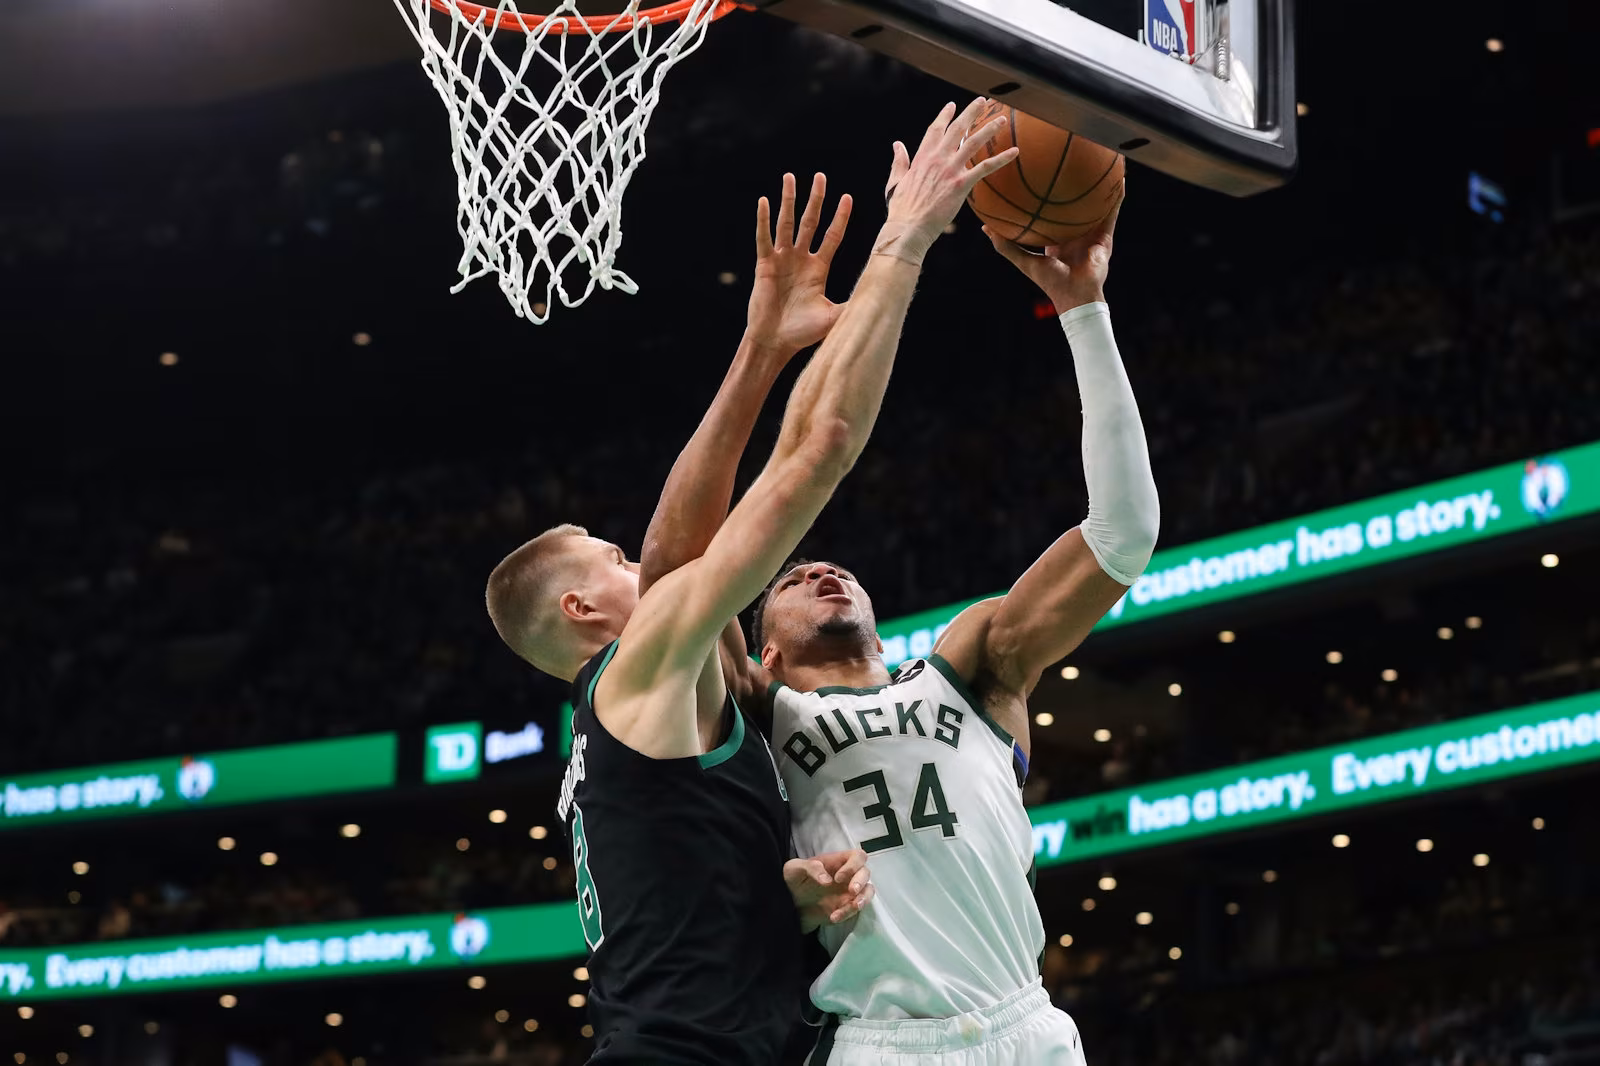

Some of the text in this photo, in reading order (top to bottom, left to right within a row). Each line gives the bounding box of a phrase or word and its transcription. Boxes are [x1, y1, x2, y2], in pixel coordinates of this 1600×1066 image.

[1153, 18, 1178, 51] NBA
[1130, 489, 1501, 606] customer has a story.
[430, 732, 476, 770] TD
[782, 699, 965, 778] BUCKS
[1331, 745, 1432, 794] Every
[4, 782, 56, 817] has
[841, 762, 960, 854] 34
[1128, 795, 1190, 834] has
[1192, 788, 1217, 821] a
[1219, 770, 1316, 816] story.
[572, 801, 605, 952] 8
[45, 953, 125, 989] Every
